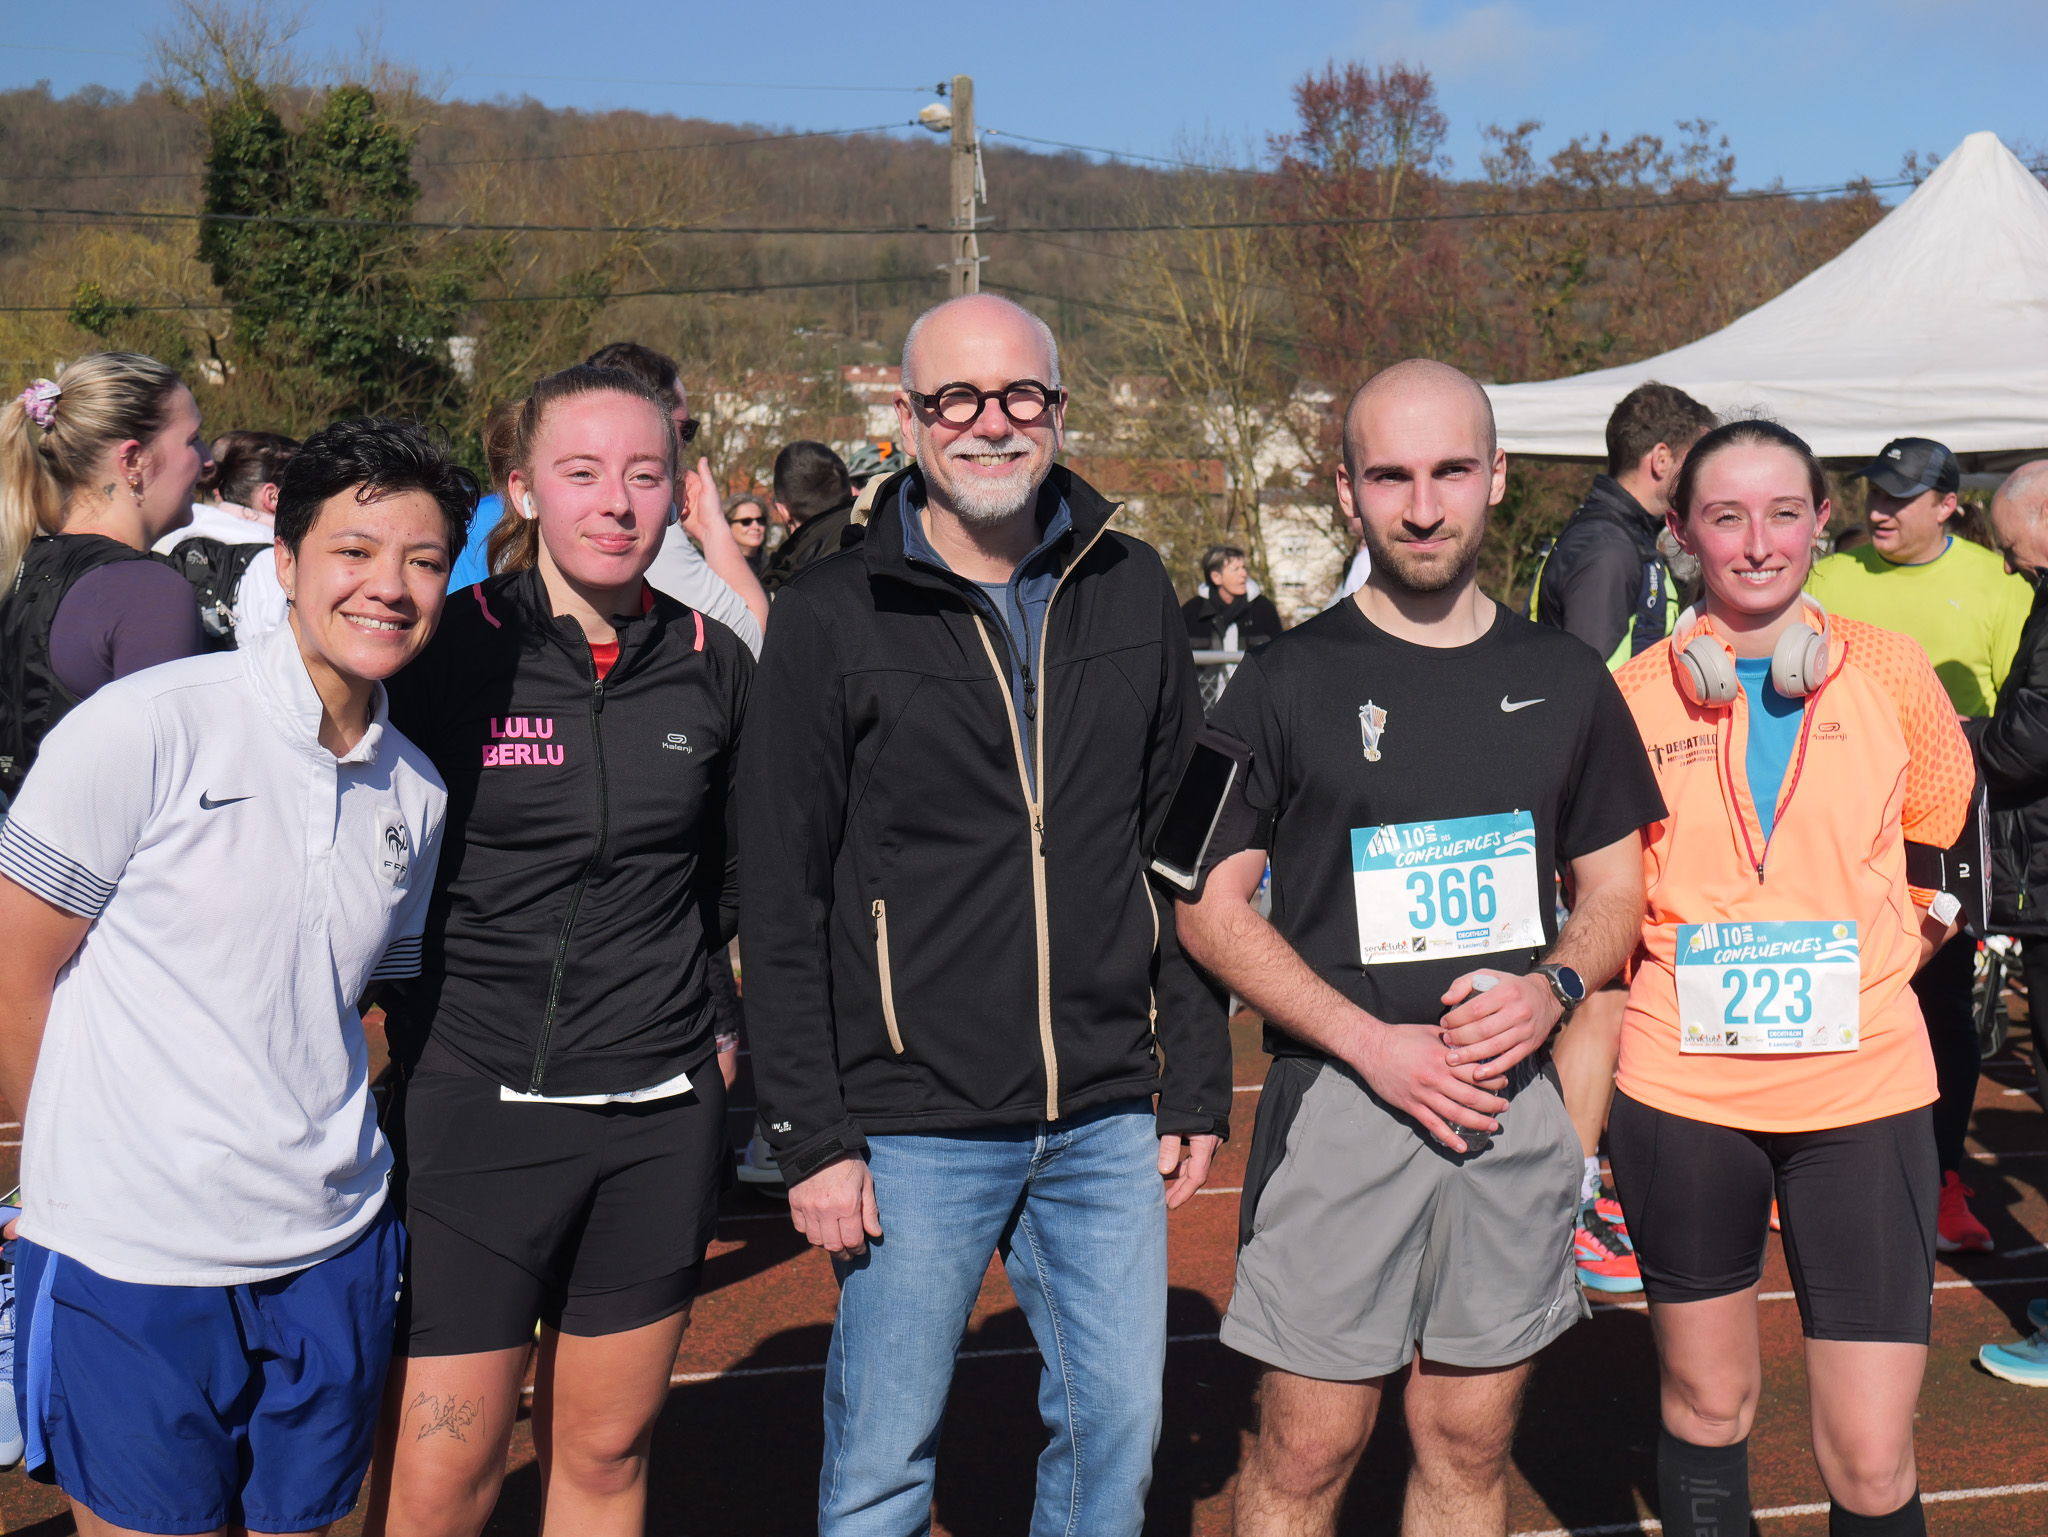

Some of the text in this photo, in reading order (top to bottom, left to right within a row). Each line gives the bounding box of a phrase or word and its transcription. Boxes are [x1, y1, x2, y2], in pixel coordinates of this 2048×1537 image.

[490, 717, 554, 739] LULU
[482, 743, 565, 767] BERLU
[662, 742, 693, 754] Kalenji
[1402, 825, 1451, 849] 10 KM DES
[1396, 831, 1502, 868] CONFLUENCES
[384, 860, 407, 874] FFF
[1406, 864, 1497, 930] 366
[1457, 929, 1489, 939] DECATHLON
[1722, 925, 1767, 947] 10 KM DES
[1713, 937, 1822, 964] CONFLUENCES
[1722, 967, 1812, 1025] 223
[1768, 1030, 1802, 1038] DECATHLON
